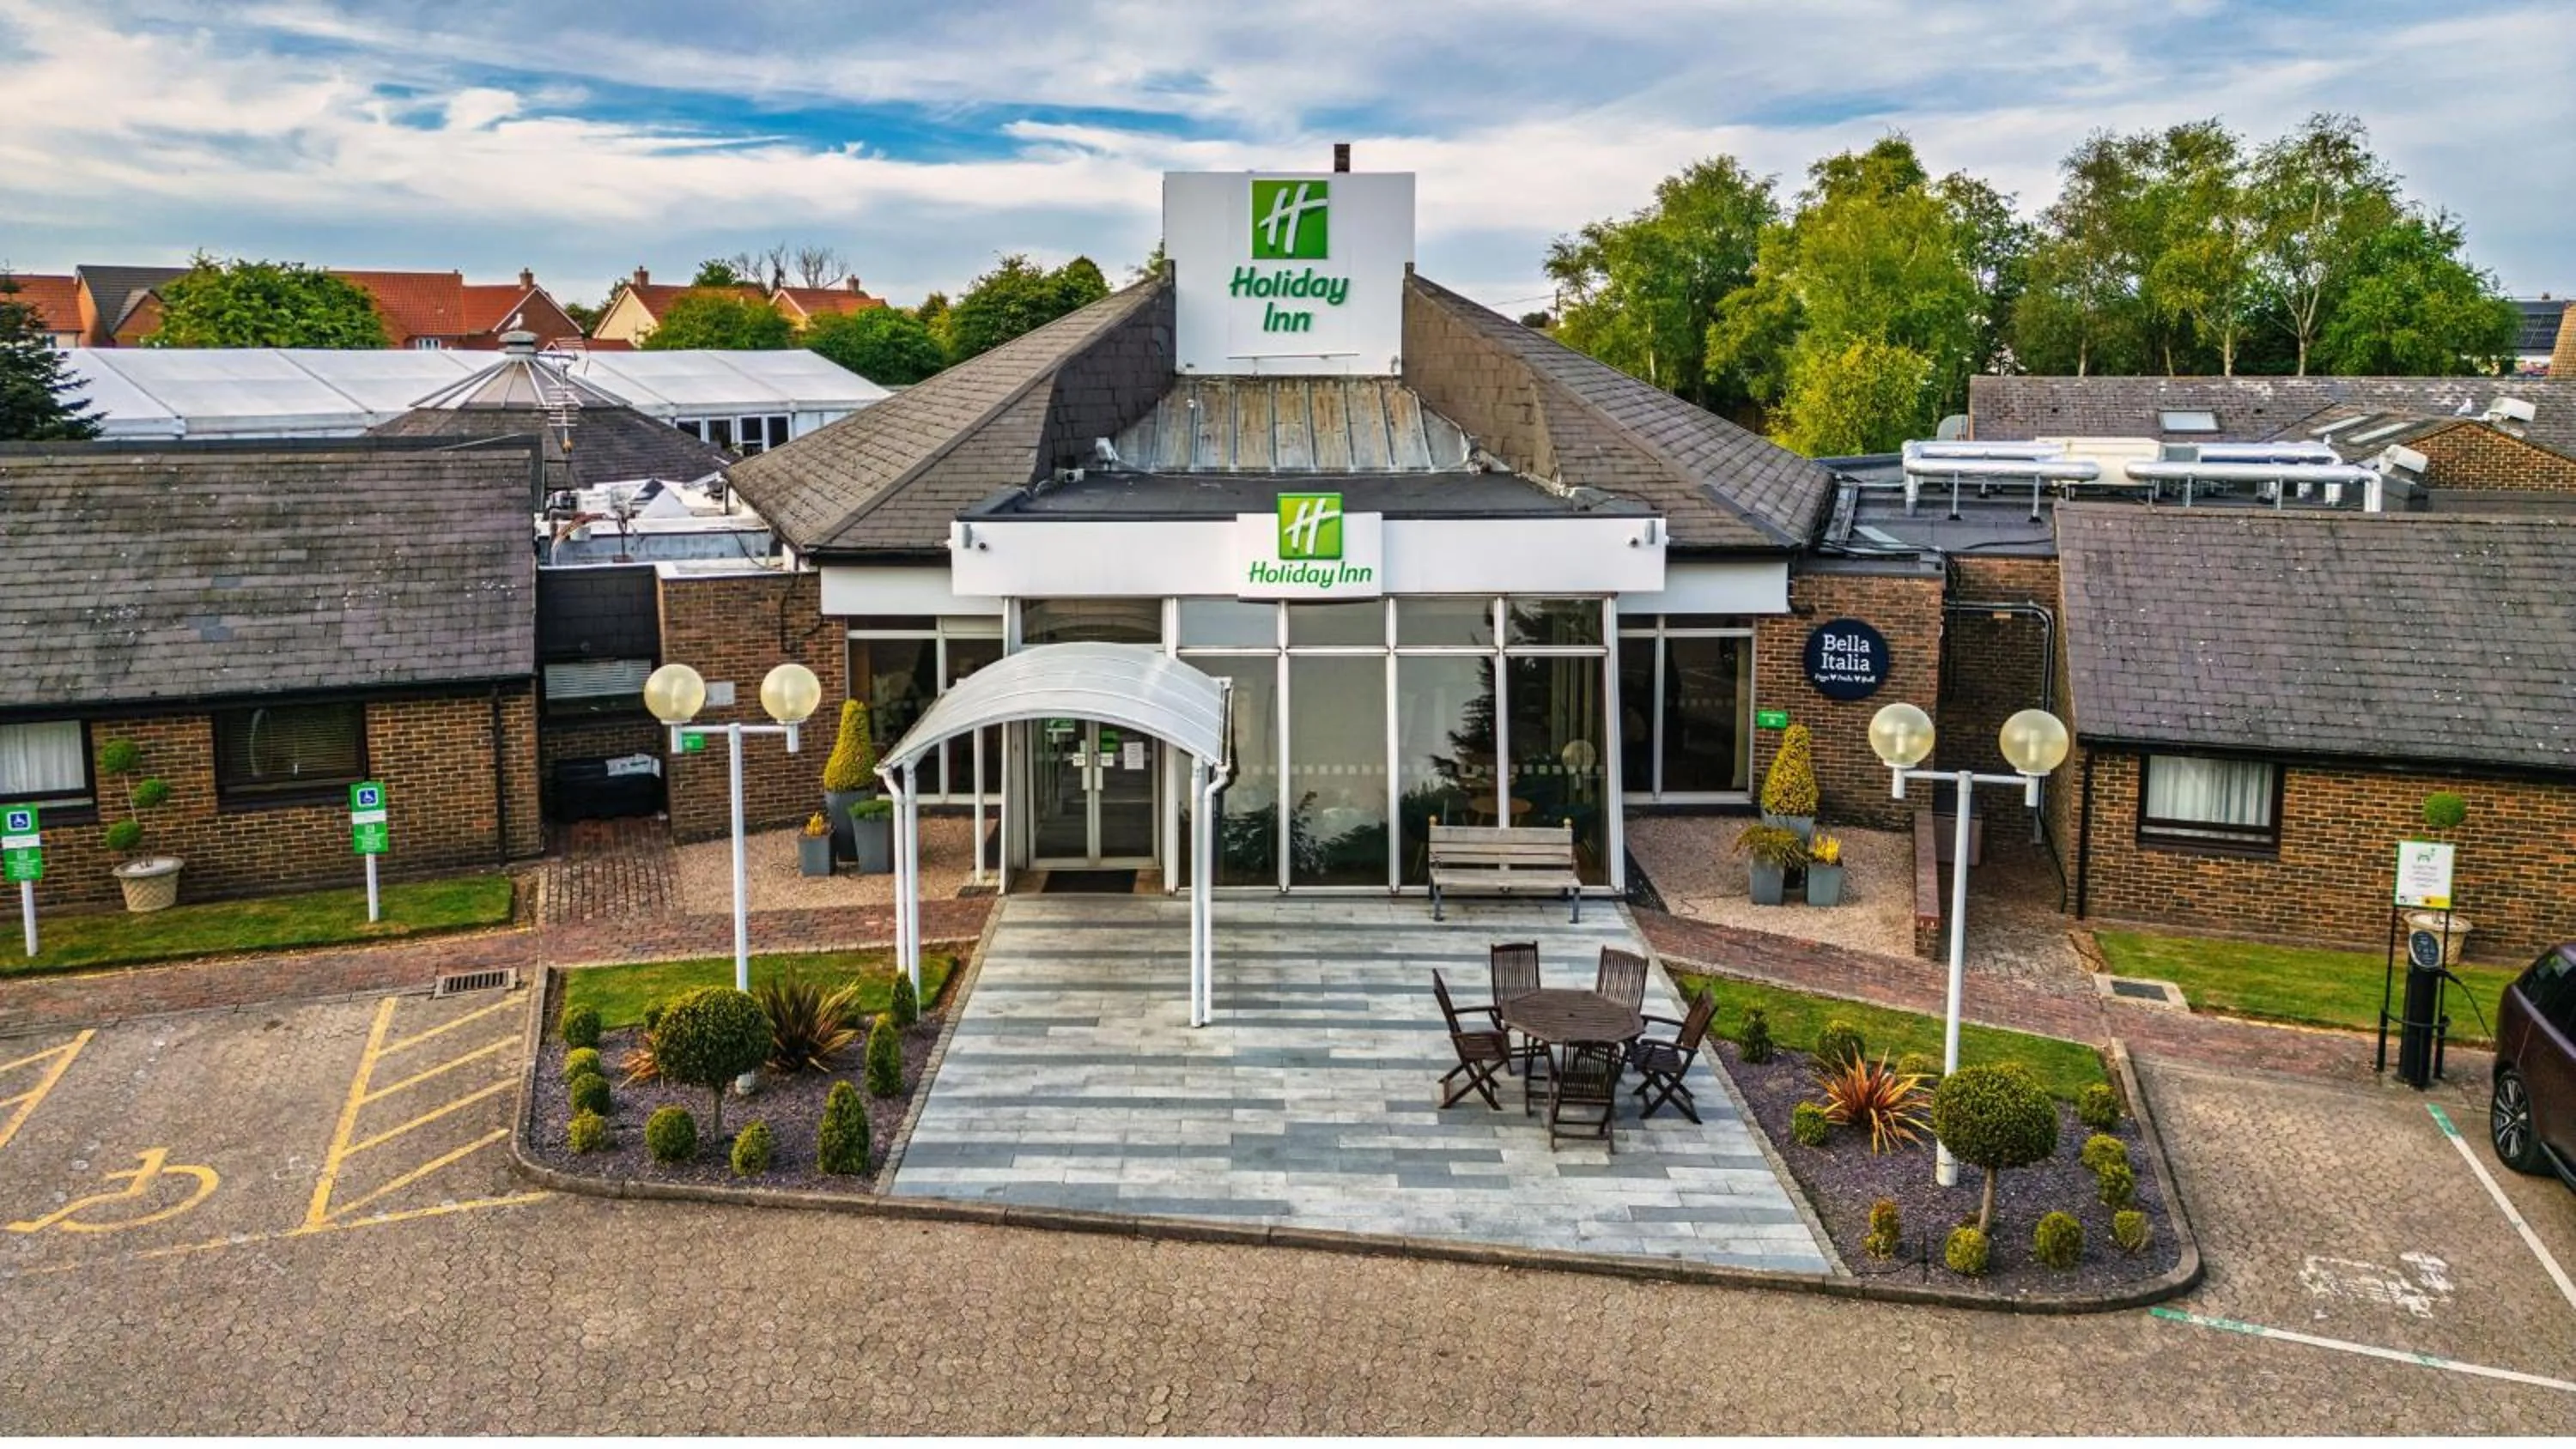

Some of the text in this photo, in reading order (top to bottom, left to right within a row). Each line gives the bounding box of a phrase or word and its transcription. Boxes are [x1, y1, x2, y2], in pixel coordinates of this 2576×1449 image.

[1229, 265, 1350, 306] Holiday
[1262, 301, 1313, 332] Inn
[1249, 561, 1373, 588] Holiday Inn
[1821, 634, 1871, 653] Bella
[1820, 652, 1871, 672] Italia
